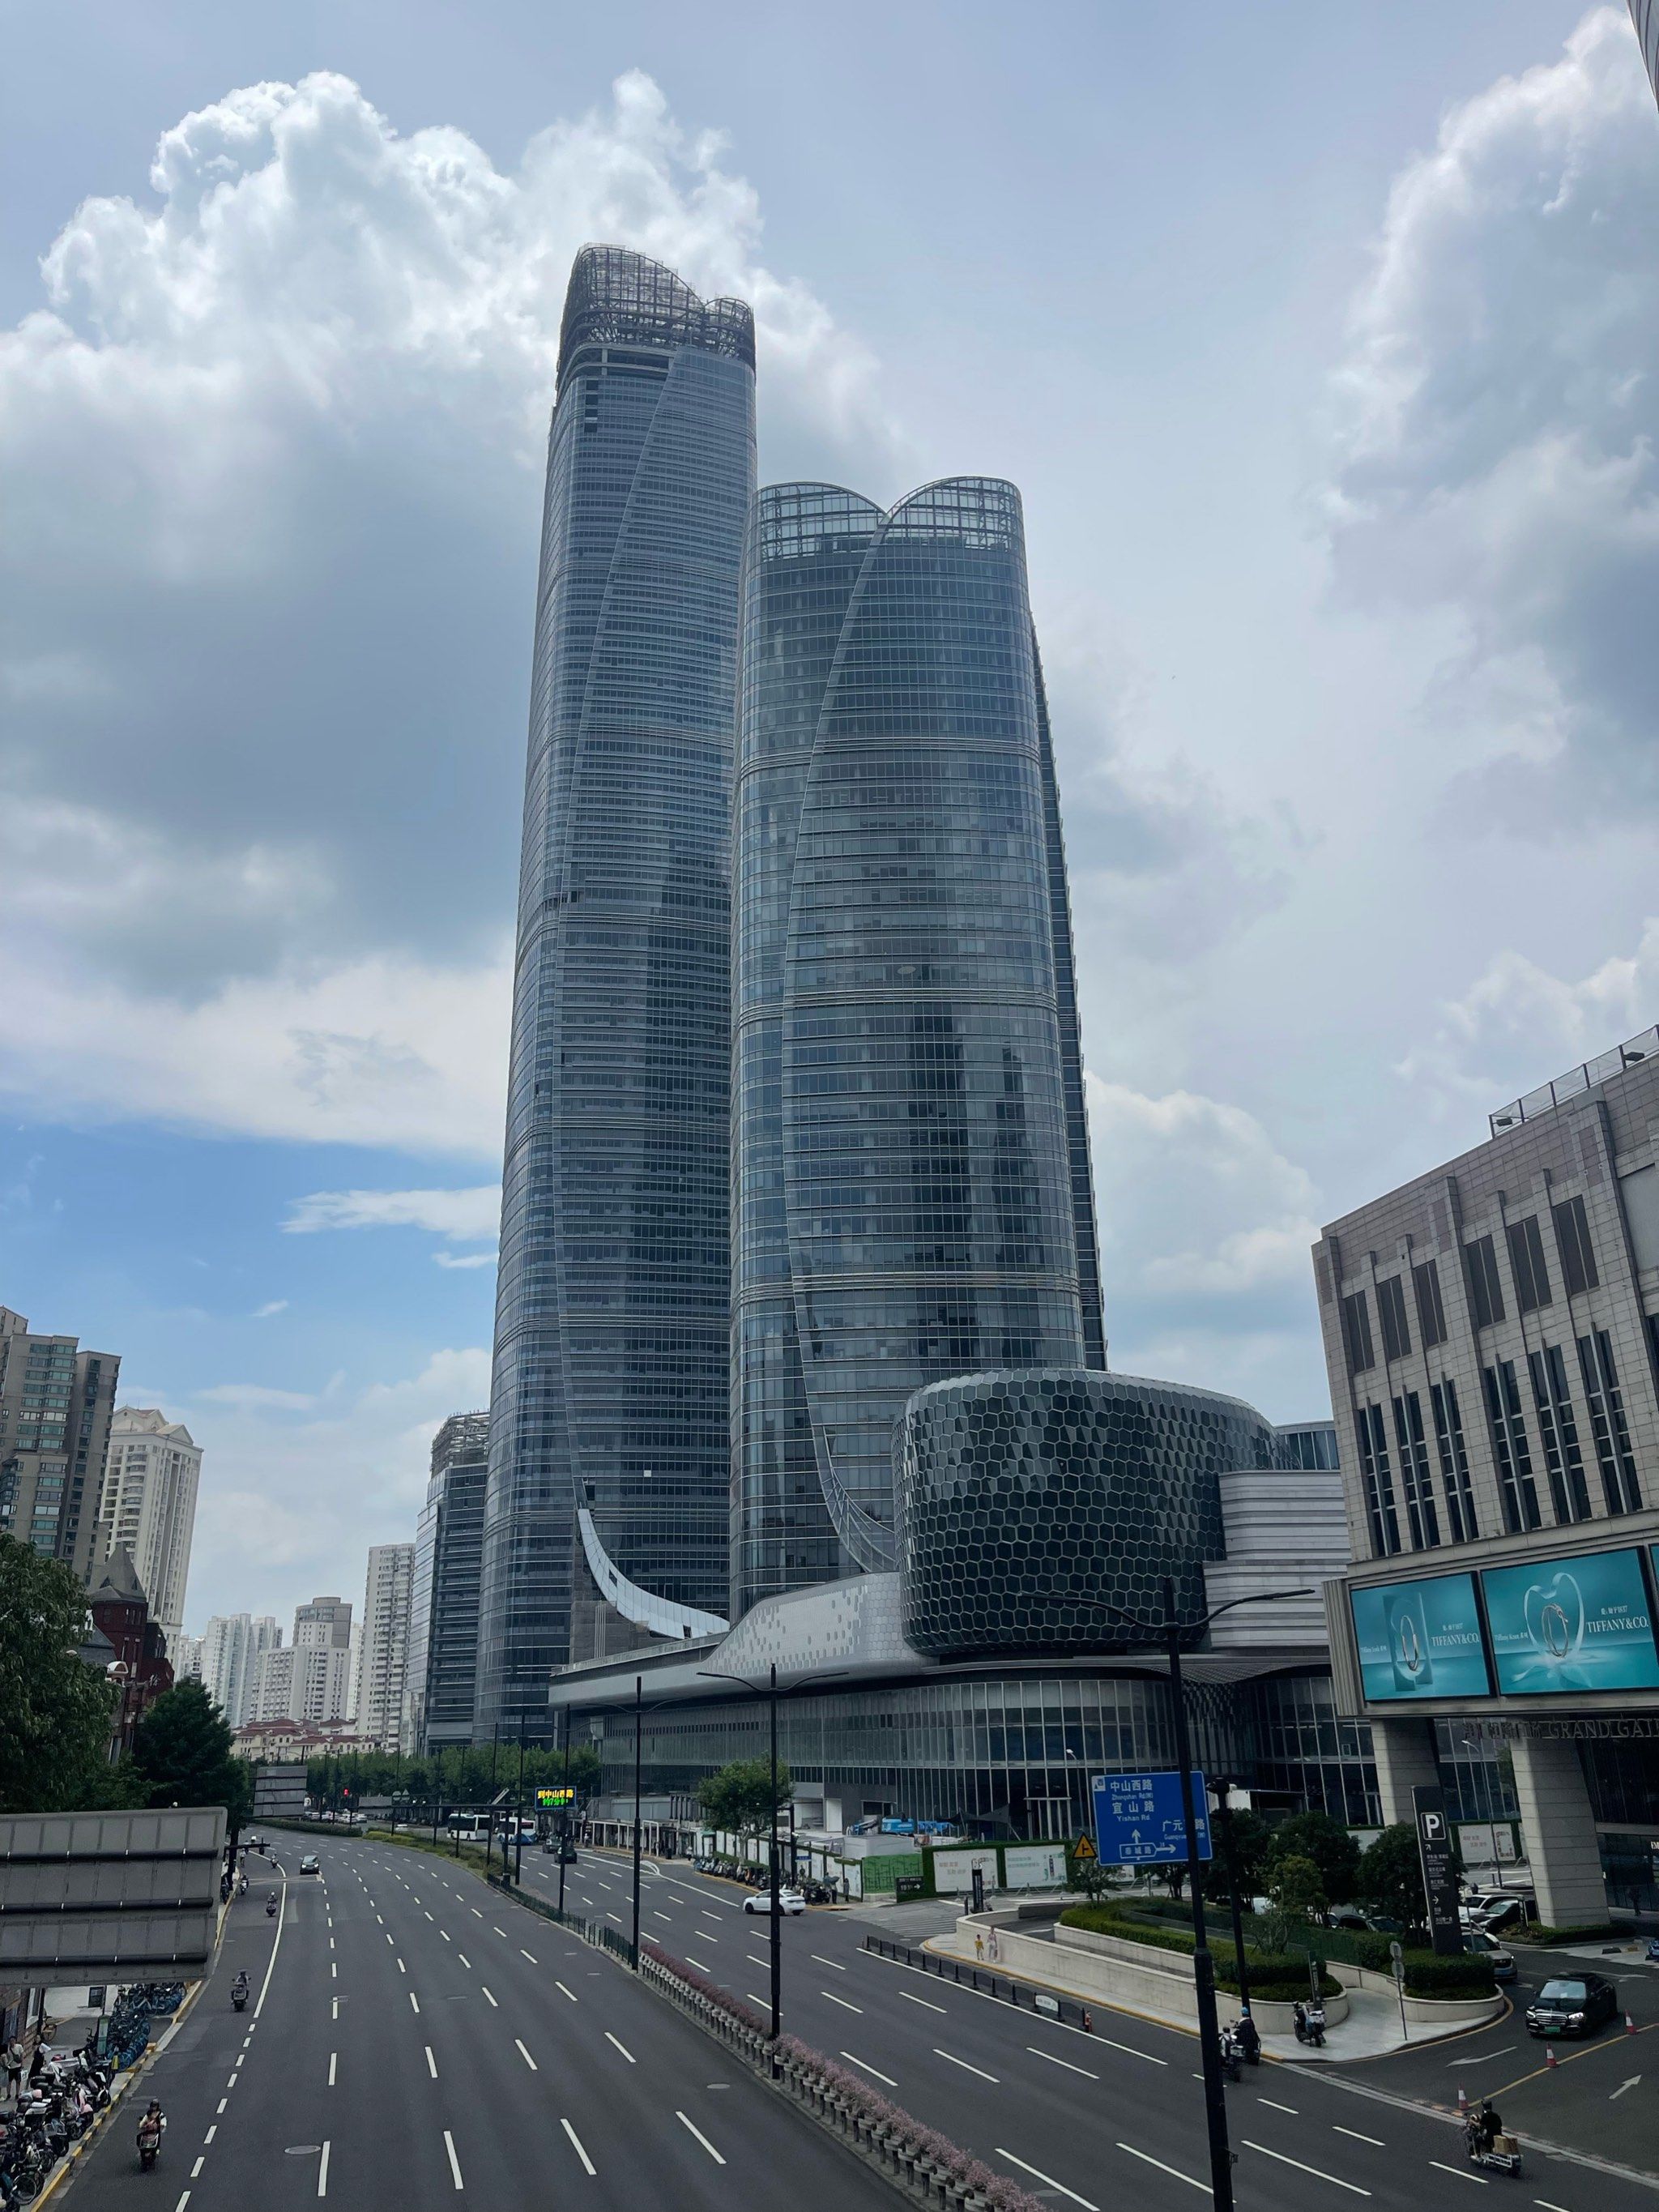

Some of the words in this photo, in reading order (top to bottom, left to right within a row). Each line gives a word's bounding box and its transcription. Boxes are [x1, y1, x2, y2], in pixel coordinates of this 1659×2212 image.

[1548, 1720, 1610, 1739] GRAND
[1110, 1779, 1153, 1792] 中山西路
[538, 1789, 574, 1799] 到中山西路
[1111, 1800, 1154, 1814] 宜山路
[1162, 1817, 1205, 1832] 广元路
[1425, 1814, 1439, 1838] P
